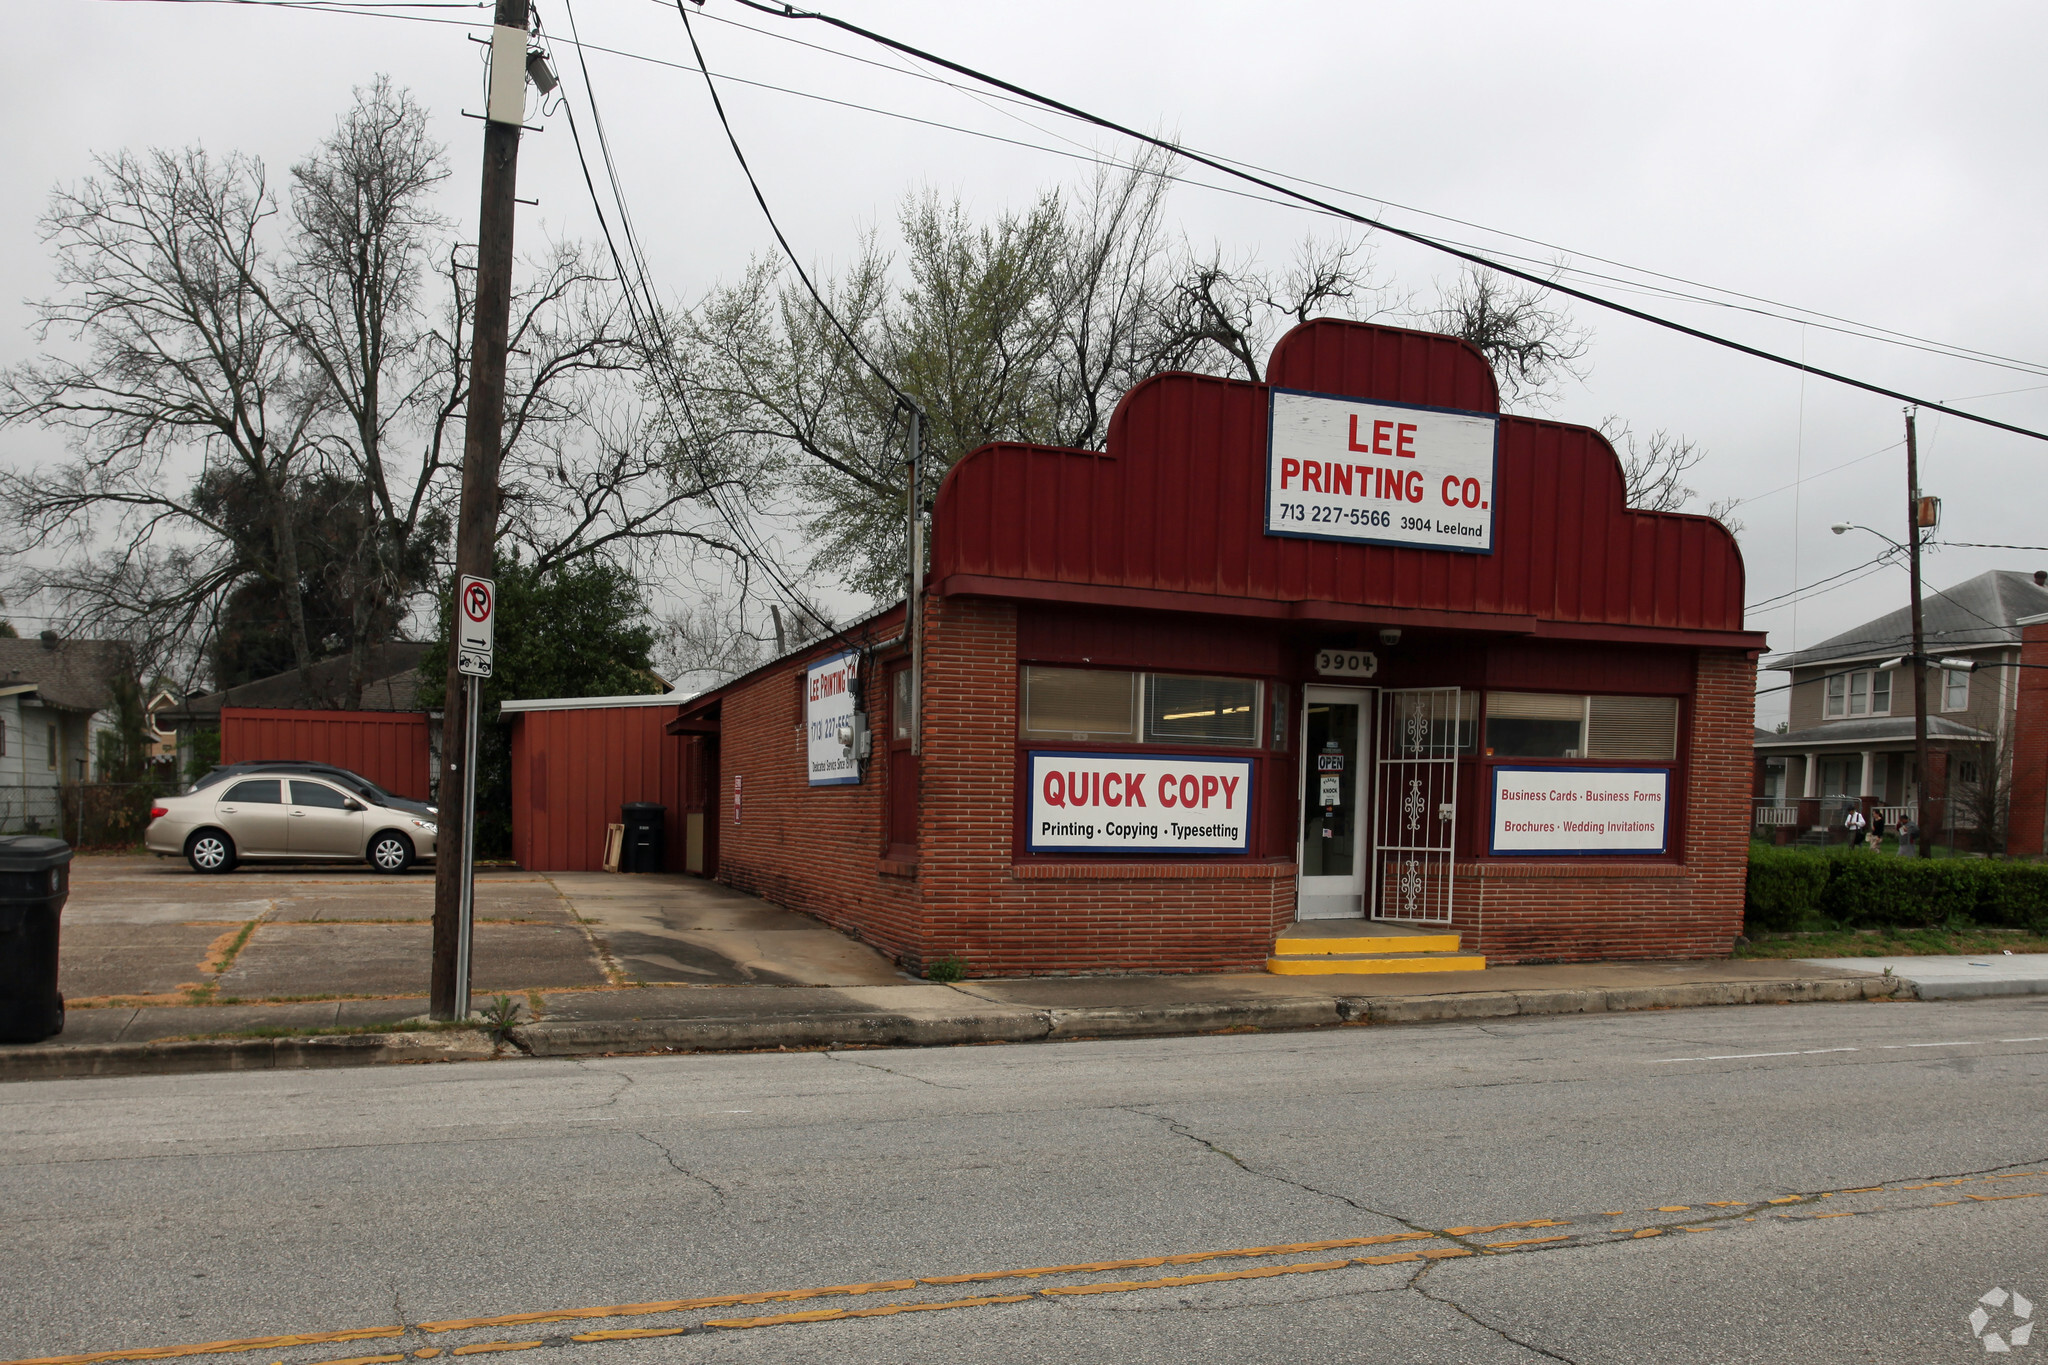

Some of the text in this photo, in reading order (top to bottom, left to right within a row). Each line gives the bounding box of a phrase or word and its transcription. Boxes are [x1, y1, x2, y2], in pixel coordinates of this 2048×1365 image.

[1348, 413, 1418, 459] LEE
[1280, 457, 1489, 510] PRINTING CO.
[1280, 503, 1483, 538] 713 227-5566 3904 Leeland
[1320, 653, 1374, 672] 3904
[1319, 755, 1343, 769] OPEN
[1043, 770, 1240, 810] QUICK COPY
[1501, 789, 1662, 802] Business Cards Business Forms
[1042, 821, 1239, 841] Printing Copying Typesetting
[1504, 820, 1655, 835] Brochures Wedding Invitations
